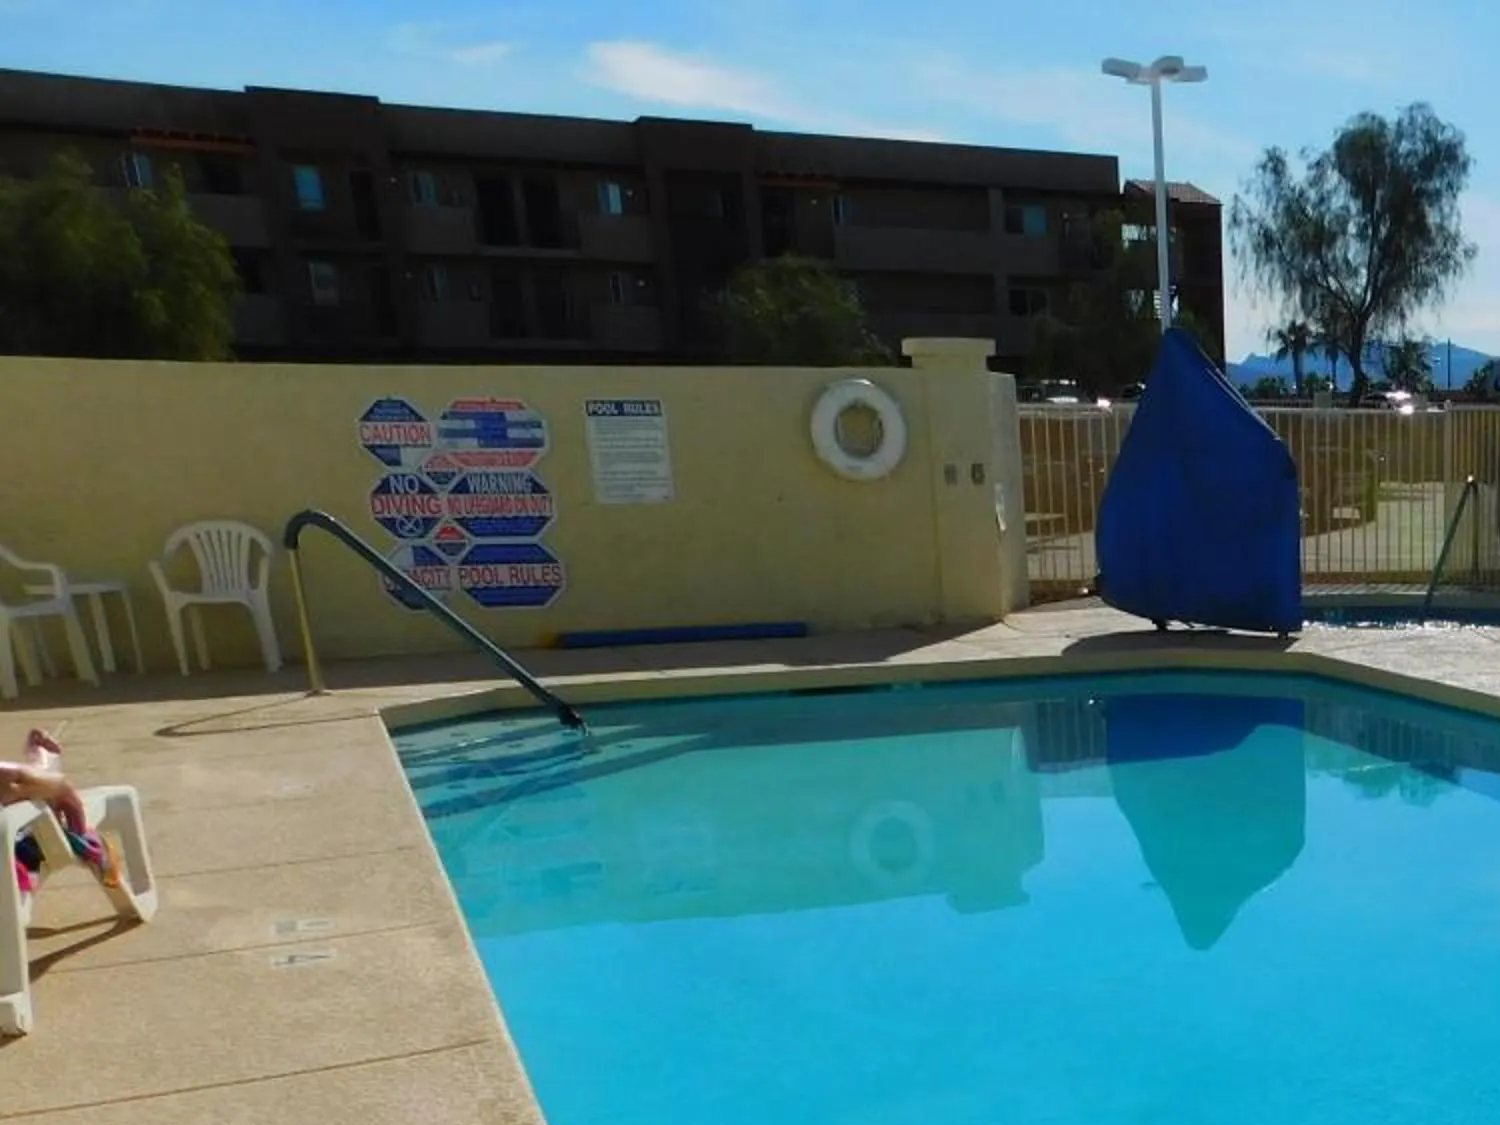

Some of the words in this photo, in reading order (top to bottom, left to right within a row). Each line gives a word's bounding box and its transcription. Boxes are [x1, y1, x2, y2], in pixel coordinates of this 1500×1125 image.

[360, 423, 432, 443] CAUTION
[389, 475, 419, 494] NO
[466, 473, 533, 494] WARNING
[372, 495, 441, 514] DIVING
[458, 566, 504, 585] POOL
[508, 564, 563, 585] RULES
